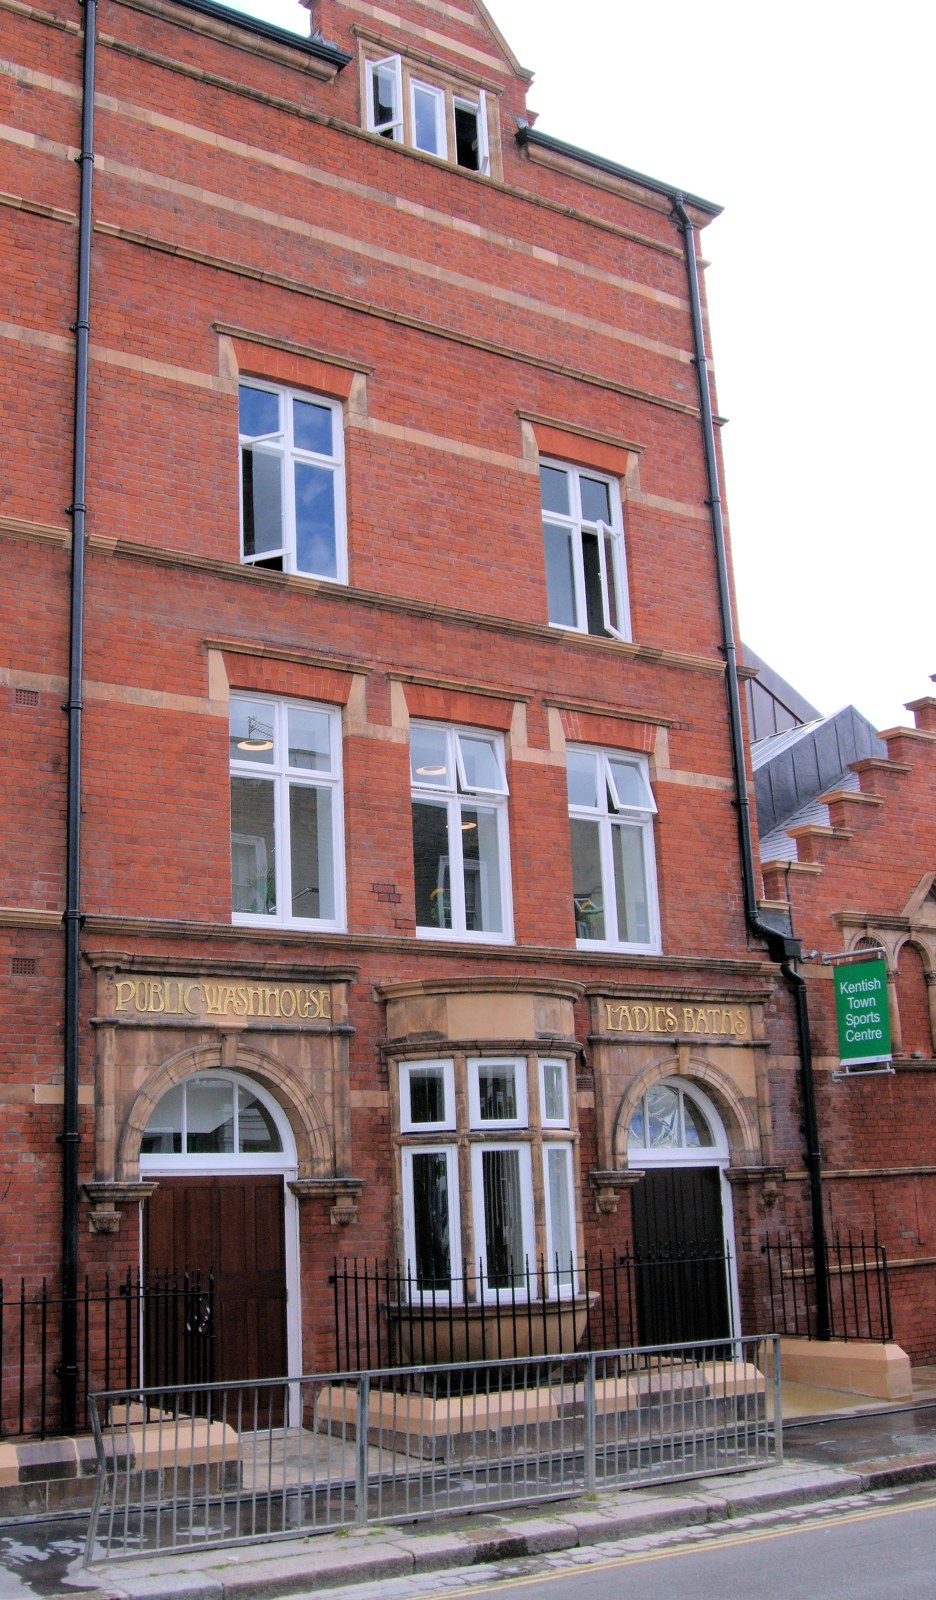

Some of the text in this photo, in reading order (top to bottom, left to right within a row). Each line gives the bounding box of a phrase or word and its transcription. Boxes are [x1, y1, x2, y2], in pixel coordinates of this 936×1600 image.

[840, 978, 881, 994] Kentish
[115, 980, 331, 1019] PUBLIC WASHHOUSE
[847, 997, 876, 1009] Town
[605, 1004, 748, 1036] LADIES BATHS
[845, 1011, 880, 1028] Sports
[845, 1028, 882, 1042] Centre
